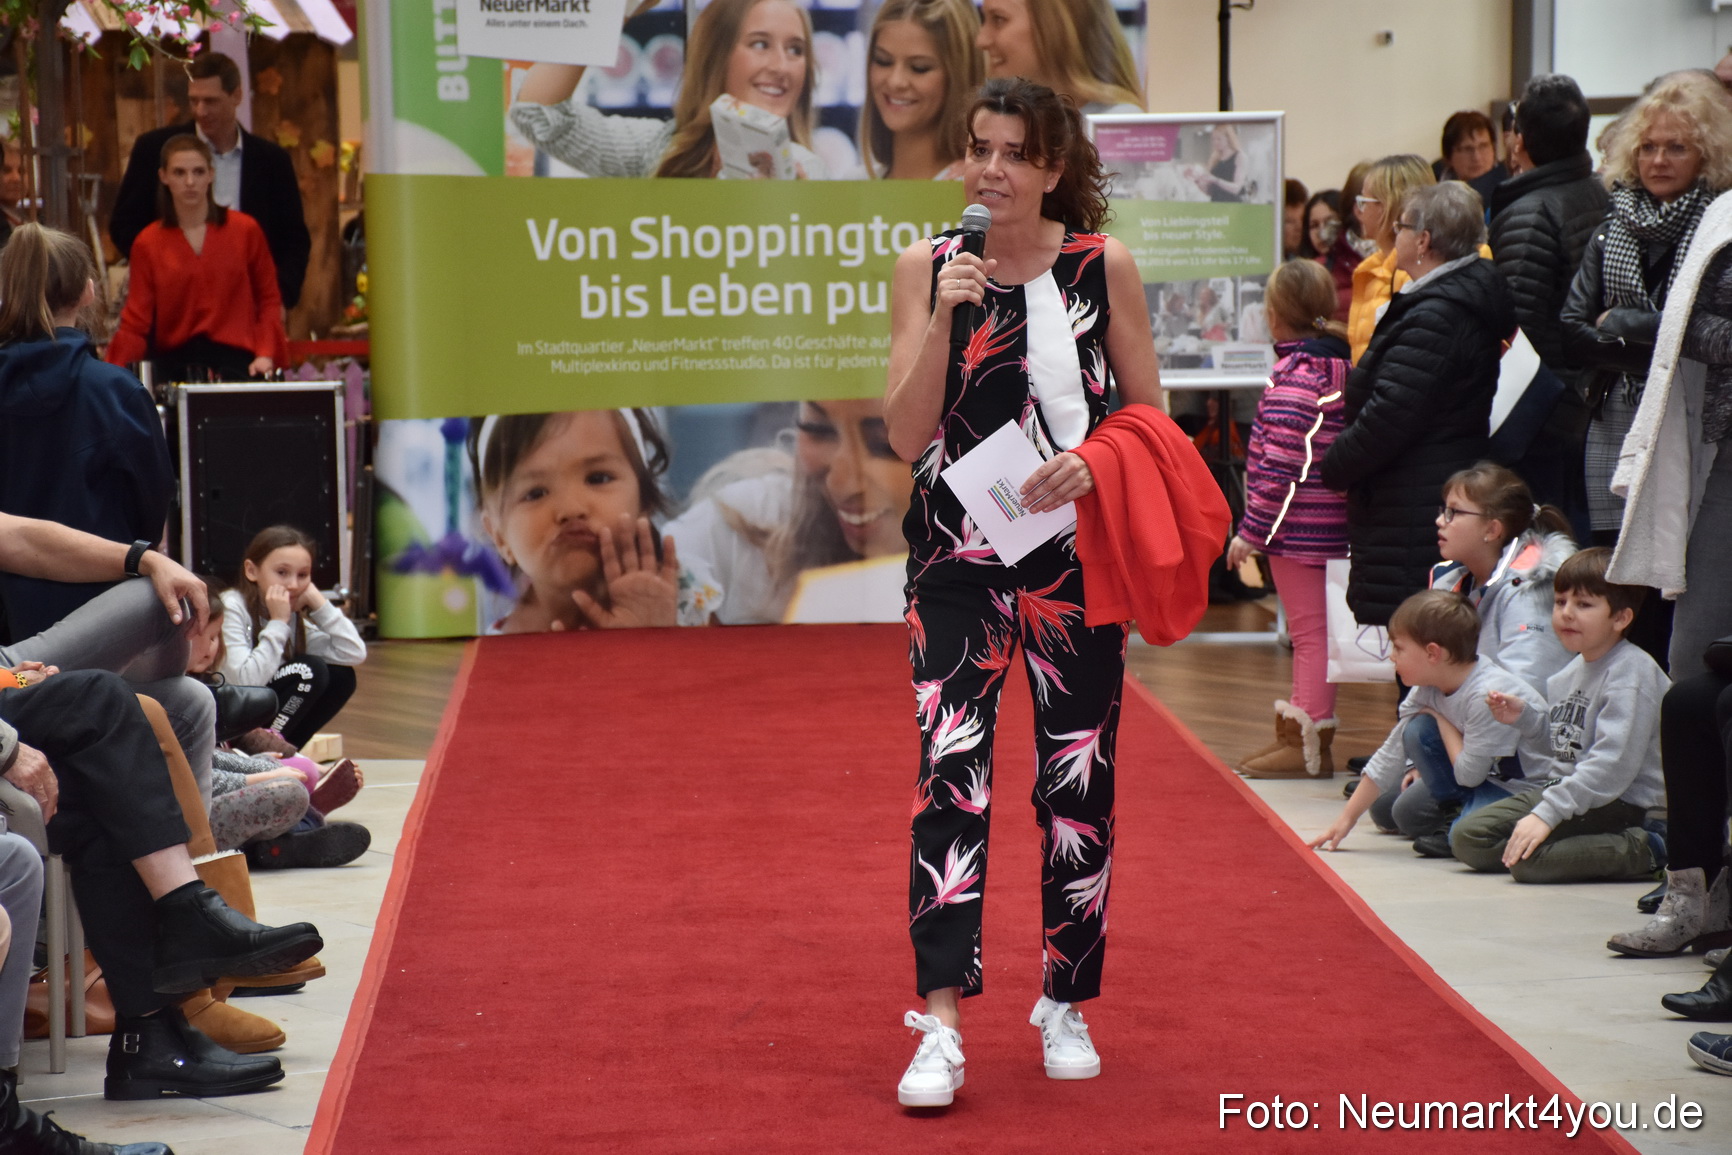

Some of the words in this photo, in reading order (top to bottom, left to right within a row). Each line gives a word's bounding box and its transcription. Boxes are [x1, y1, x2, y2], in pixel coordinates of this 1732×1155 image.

[479, 0, 591, 13] NeuerMarkt
[485, 18, 506, 28] Alles
[507, 18, 531, 28] unter
[533, 18, 560, 28] einem
[562, 18, 588, 28] Dach.
[527, 218, 617, 261] Von
[630, 214, 963, 268] Shoppingto
[580, 274, 649, 319] bis
[661, 272, 812, 316] Leben
[827, 280, 887, 325] pu
[517, 341, 533, 355] Im
[535, 340, 624, 356] Stadtquartier
[721, 336, 770, 351] treffen
[772, 335, 793, 350] 40
[795, 334, 867, 350] Geschäfte
[551, 357, 641, 375] Multiplexkino
[643, 356, 669, 372] und
[671, 353, 768, 372] Fitnessstudio.
[772, 354, 790, 369] Da
[793, 354, 811, 369] ist
[813, 353, 834, 369] für
[836, 354, 877, 371] jeden
[996, 478, 1026, 517] NeuerMarkt
